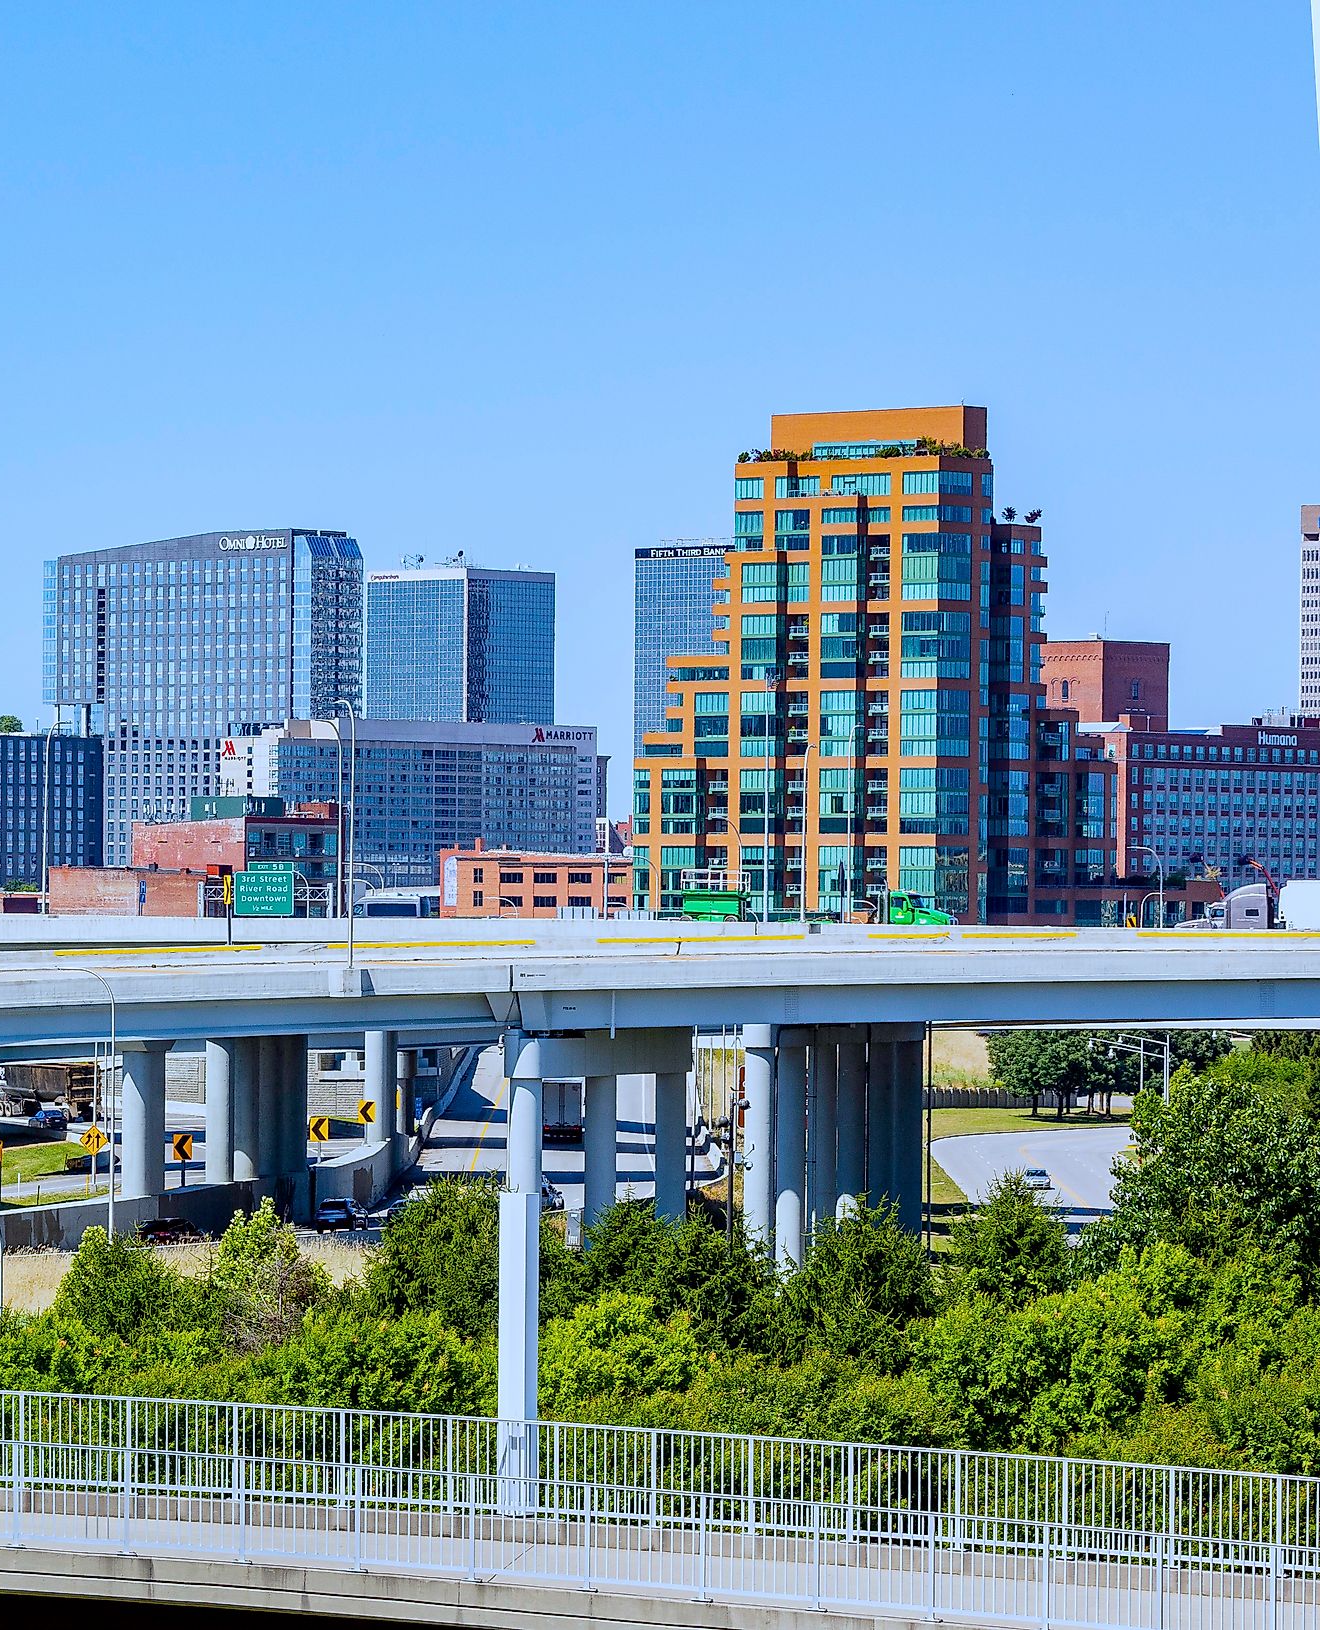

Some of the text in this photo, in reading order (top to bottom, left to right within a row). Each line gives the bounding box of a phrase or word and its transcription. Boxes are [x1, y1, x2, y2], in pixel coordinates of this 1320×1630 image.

[218, 535, 287, 551] OMNI HOTEL
[650, 547, 727, 558] FIFTH THIRD BANK
[546, 730, 594, 741] MARRIOTT
[1257, 731, 1298, 746] Humana
[241, 875, 287, 883] 3rd Street
[239, 885, 288, 893] River Road
